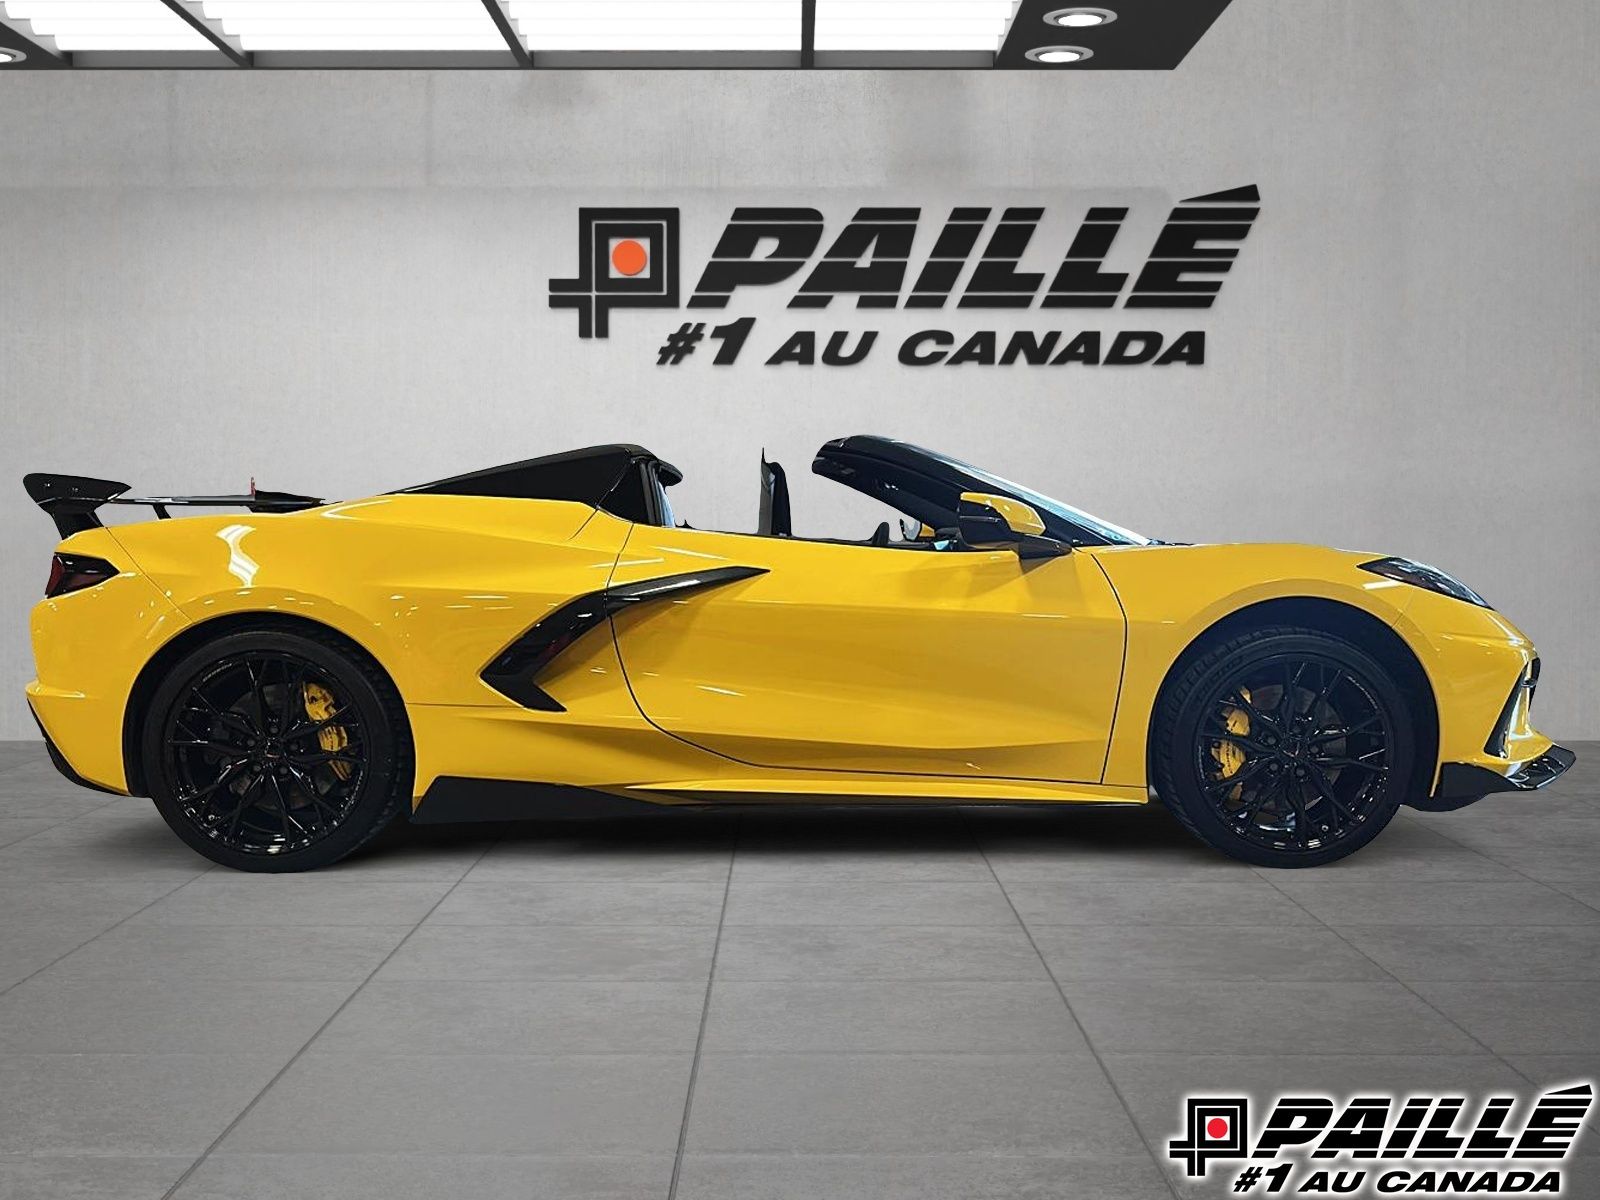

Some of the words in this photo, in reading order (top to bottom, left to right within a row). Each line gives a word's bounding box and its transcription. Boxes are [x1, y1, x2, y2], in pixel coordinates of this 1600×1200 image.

[686, 183, 1261, 309] PAILLÉ
[656, 317, 757, 366] #1
[764, 331, 879, 367] AU
[897, 330, 1206, 367] CANADA
